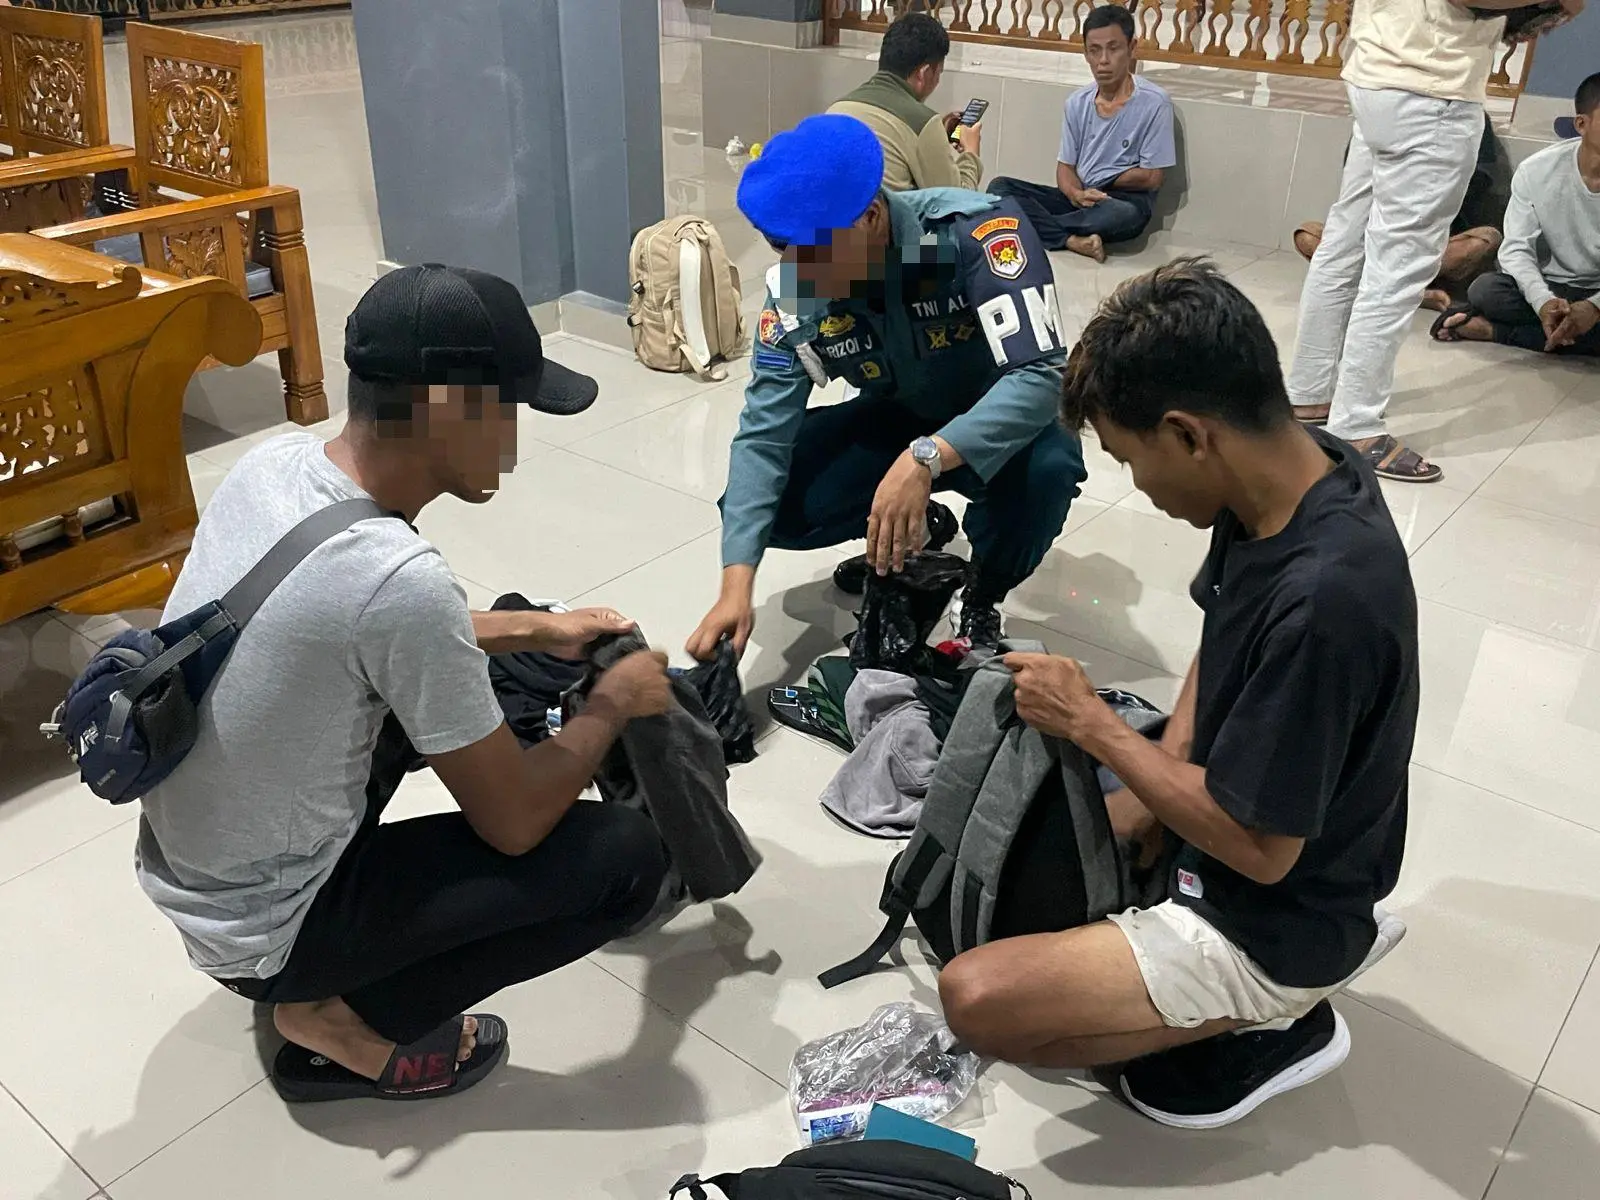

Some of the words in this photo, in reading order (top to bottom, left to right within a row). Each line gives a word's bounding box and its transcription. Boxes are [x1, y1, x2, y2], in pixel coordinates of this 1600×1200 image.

[912, 300, 939, 317] TNI
[948, 295, 968, 313] AL
[976, 284, 1066, 367] PM
[826, 335, 860, 359] RIZQI
[864, 334, 873, 350] J
